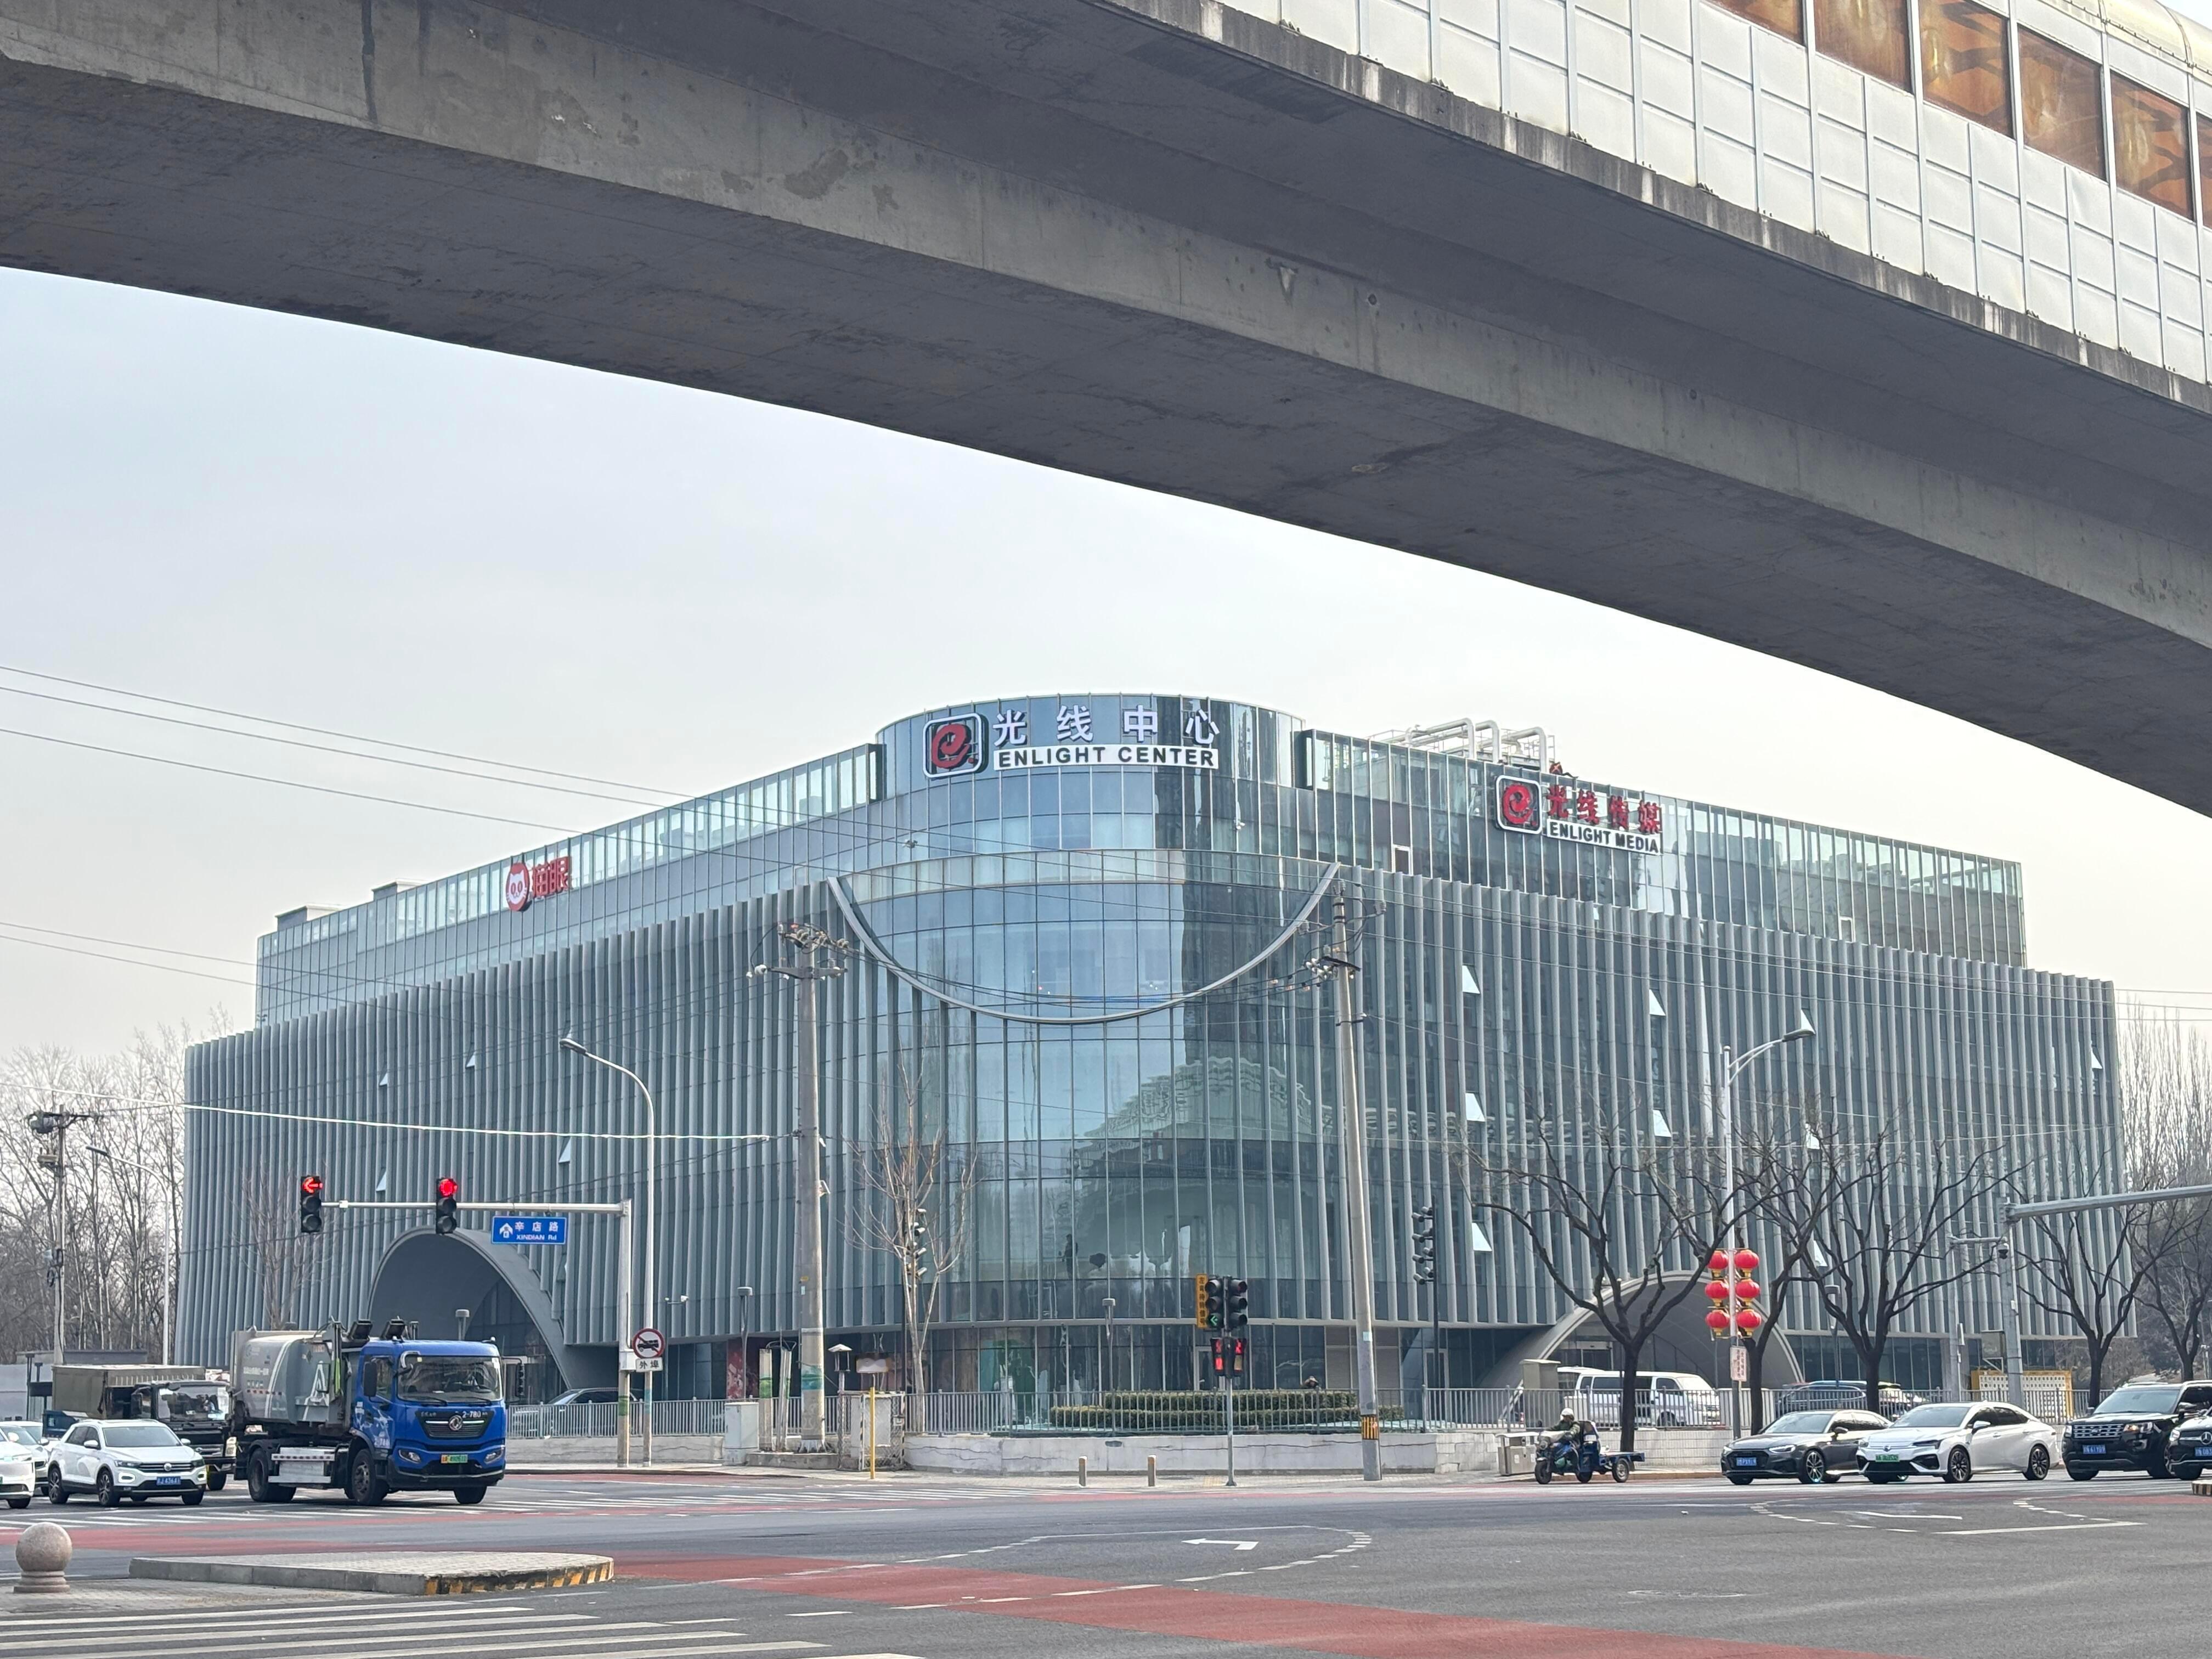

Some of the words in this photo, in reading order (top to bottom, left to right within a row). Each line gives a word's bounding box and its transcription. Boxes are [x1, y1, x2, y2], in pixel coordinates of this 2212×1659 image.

[994, 705, 1219, 746] 光线中心
[999, 747, 1106, 766] ENLIGHT
[1118, 747, 1214, 766] CENTER
[1547, 785, 1661, 834] 光线传媒
[1550, 822, 1611, 844] ENLIGHT
[1616, 833, 1658, 854] MEDIA
[532, 856, 571, 898] 猫眼
[515, 1222, 558, 1231] 辛店路
[640, 1360, 659, 1369] 外埠
